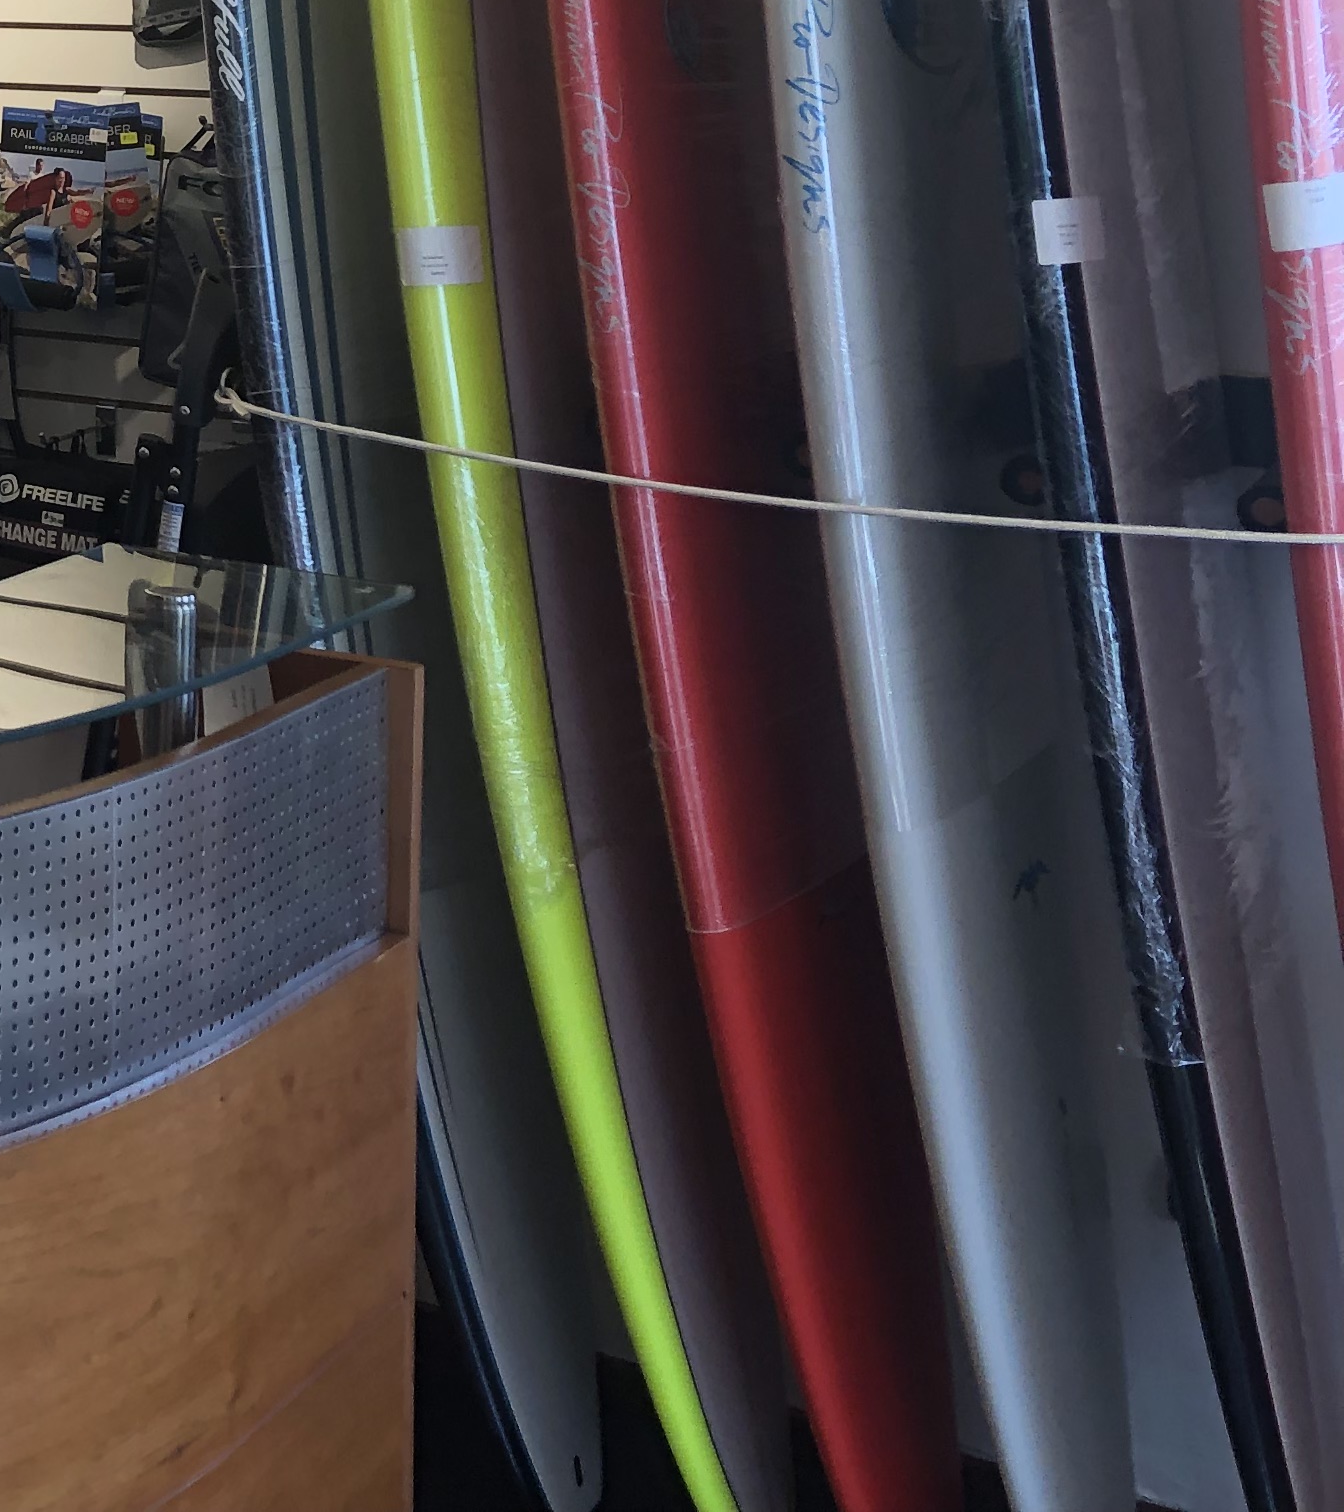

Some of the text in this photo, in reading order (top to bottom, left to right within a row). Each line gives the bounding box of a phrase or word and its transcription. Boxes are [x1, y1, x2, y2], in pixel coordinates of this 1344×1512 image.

[10, 127, 98, 147] RAIL GRABBE
[21, 483, 105, 513] FREELIFE
